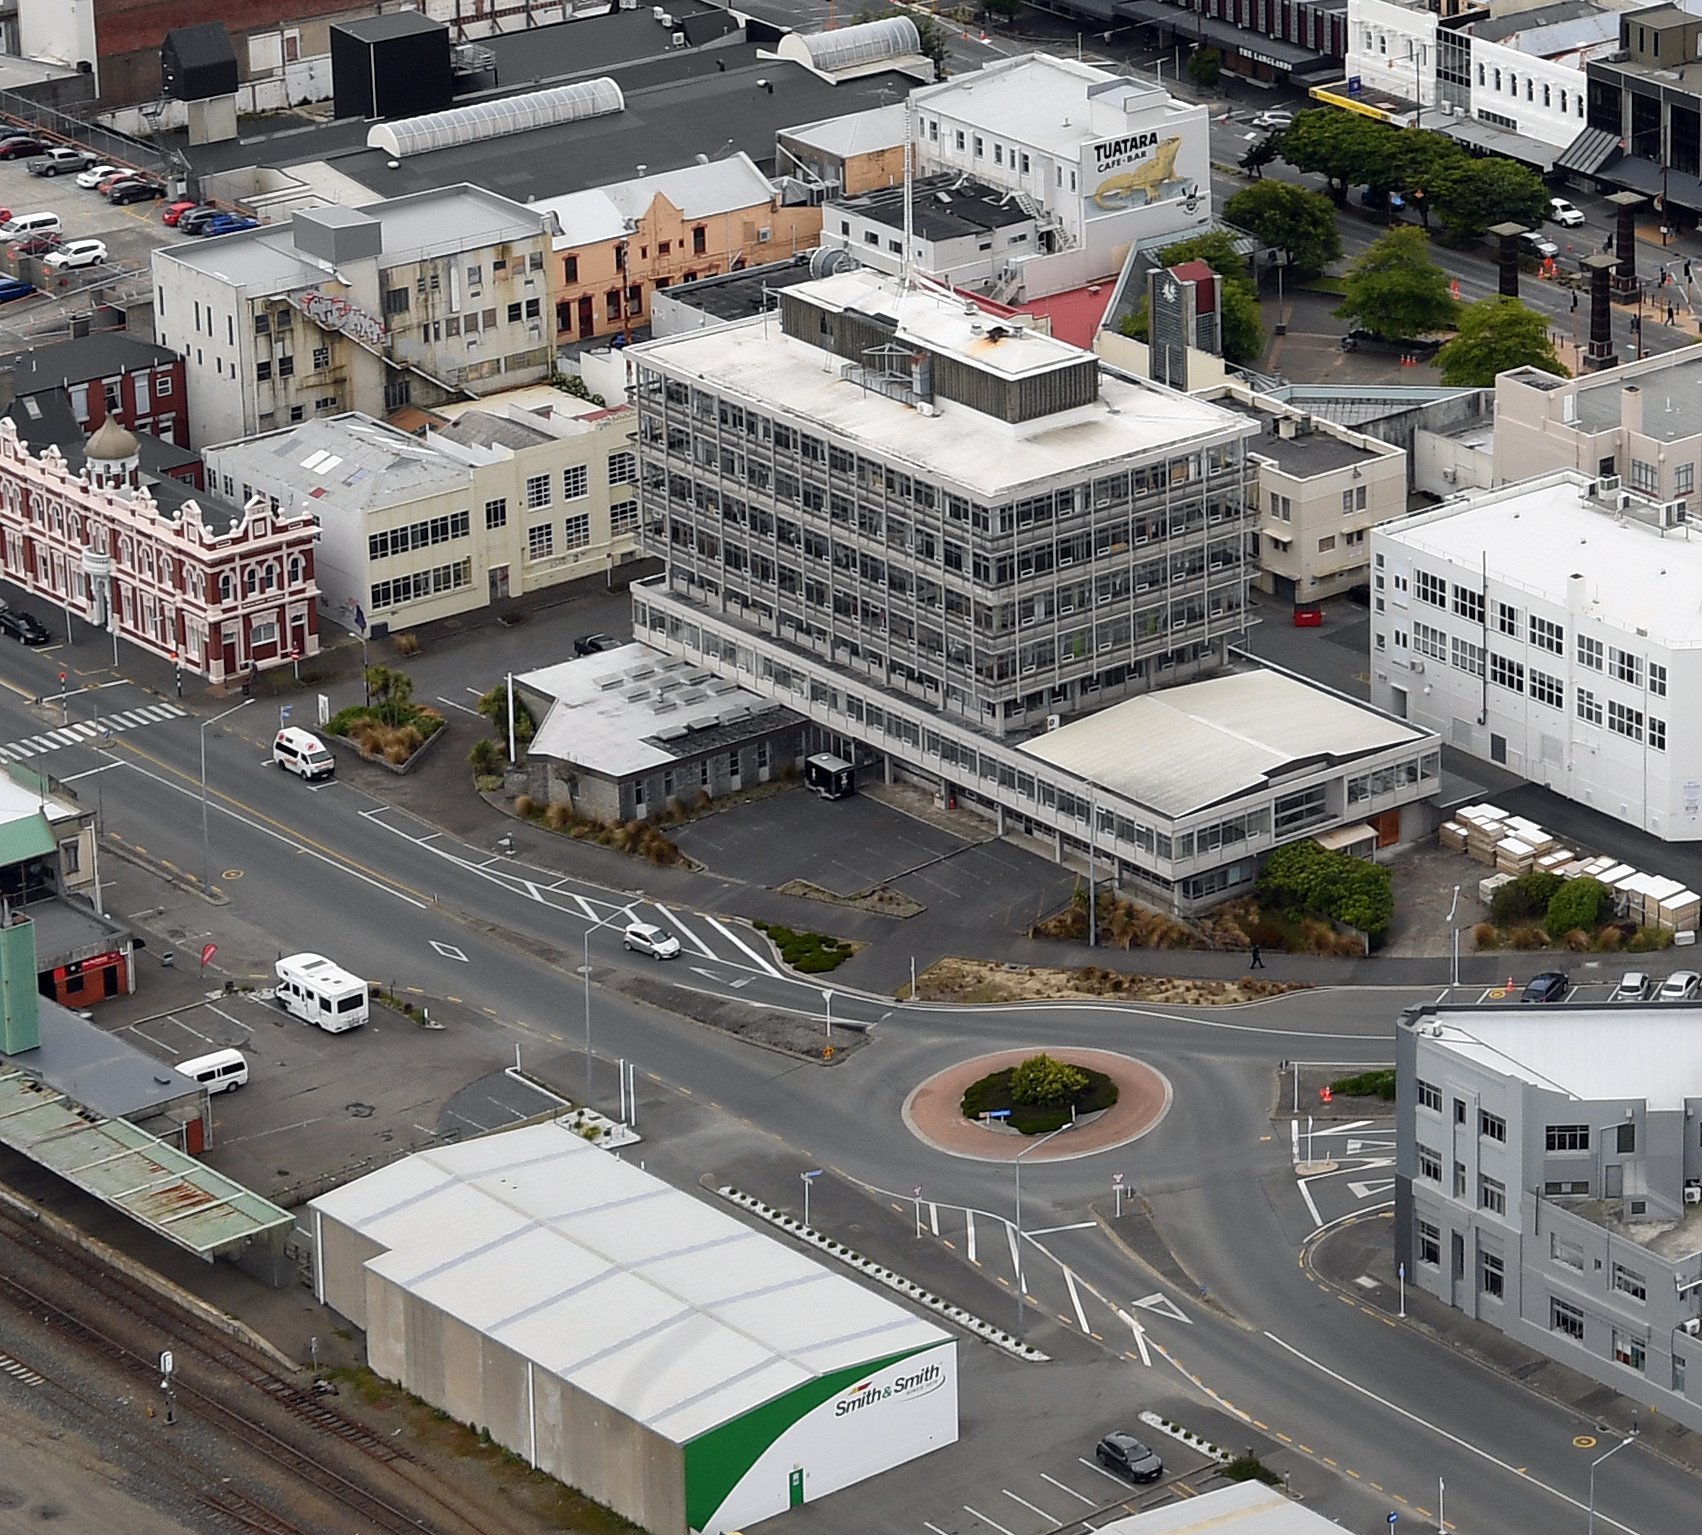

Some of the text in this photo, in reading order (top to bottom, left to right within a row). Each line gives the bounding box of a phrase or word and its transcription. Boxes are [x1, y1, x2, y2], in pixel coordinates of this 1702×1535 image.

[1238, 47, 1293, 72] THE LANGLANDS
[1094, 132, 1158, 162] TUATARA
[1097, 158, 1121, 173] CAFE
[835, 1363, 940, 1418] Smith & Smith
